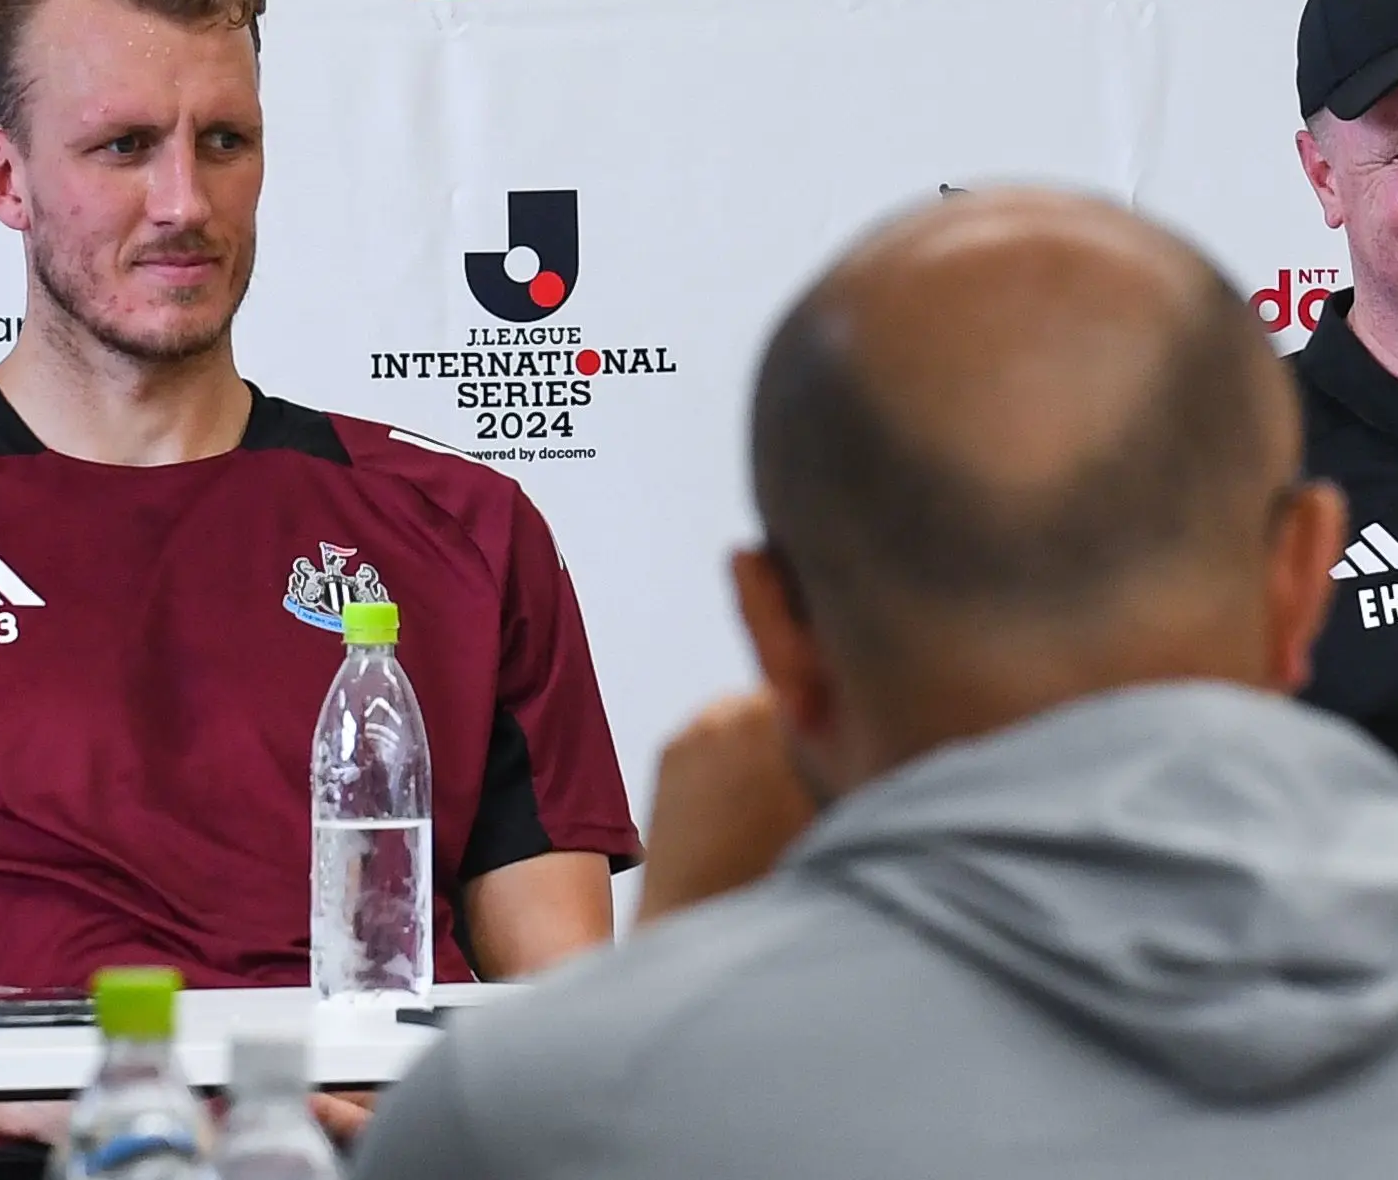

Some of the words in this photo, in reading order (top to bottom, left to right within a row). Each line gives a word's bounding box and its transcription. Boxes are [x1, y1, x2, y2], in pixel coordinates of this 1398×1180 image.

[1298, 269, 1339, 284] NTT
[466, 326, 581, 347] J.LEAGUE
[457, 380, 592, 408] SERIES
[476, 411, 574, 439] 2024
[519, 447, 536, 462] by
[539, 446, 596, 460] docomo
